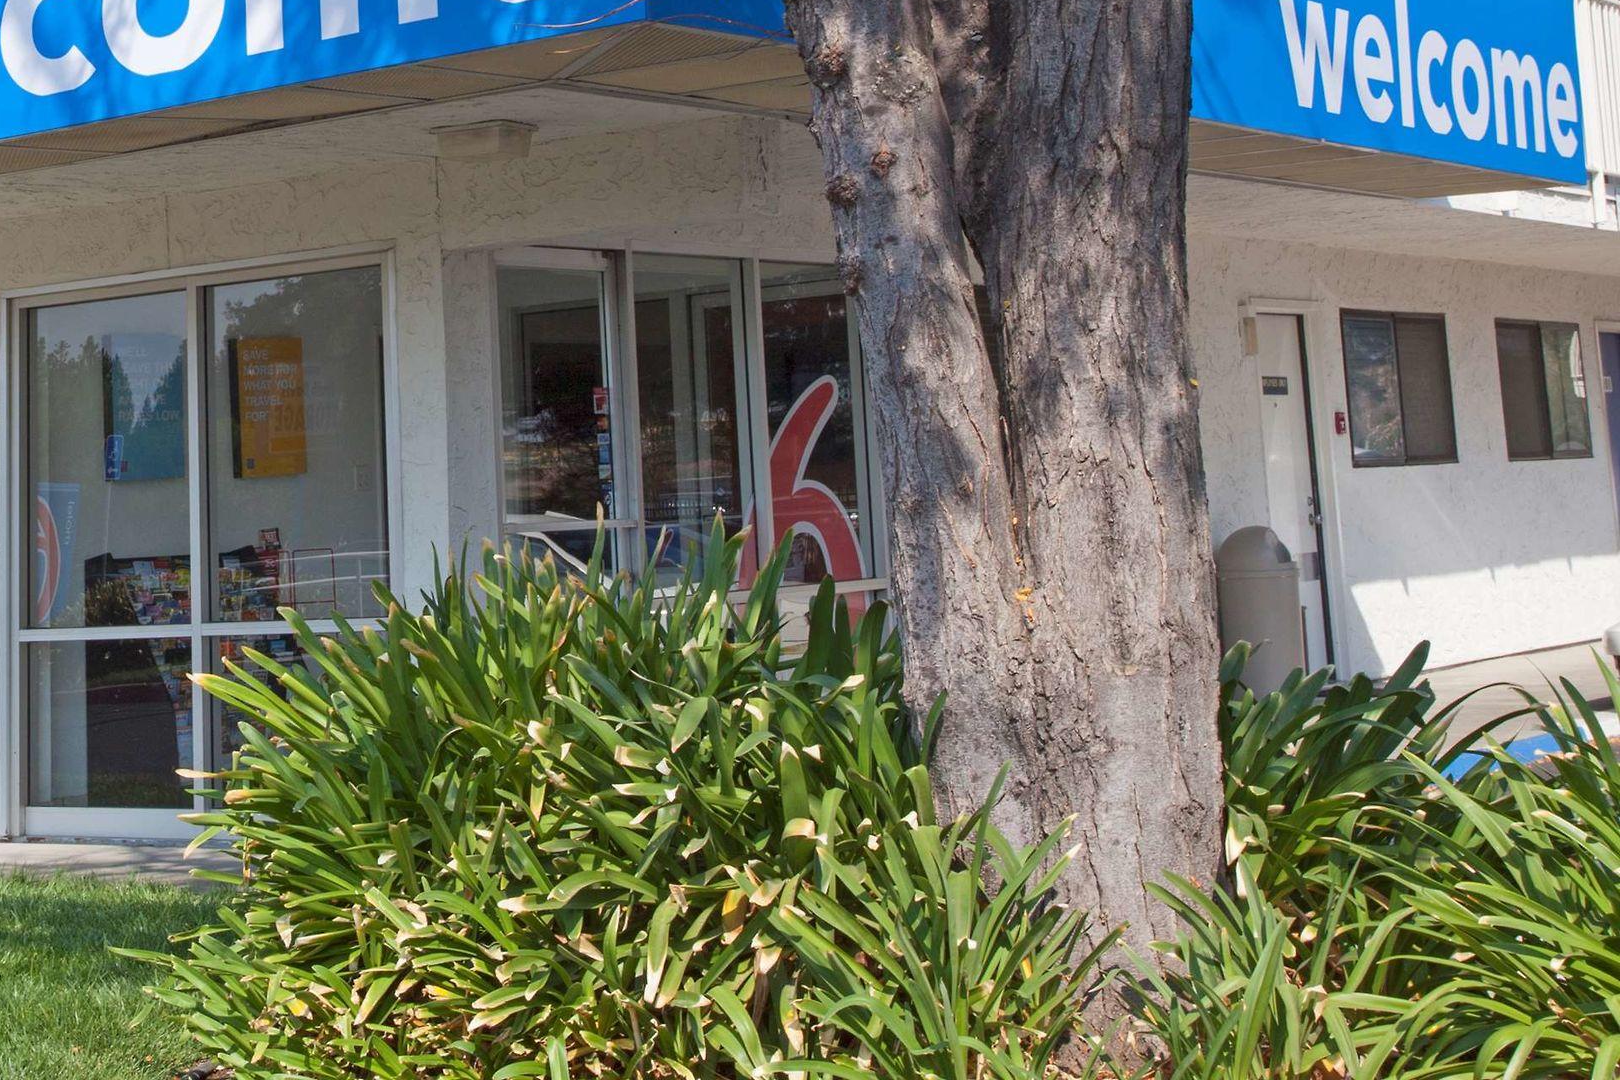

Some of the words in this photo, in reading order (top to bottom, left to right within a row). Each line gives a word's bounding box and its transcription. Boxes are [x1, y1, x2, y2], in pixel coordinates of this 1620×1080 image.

[243, 348, 269, 361] SAVE
[244, 380, 271, 392] WHAT
[275, 378, 297, 390] YOU
[246, 395, 285, 408] TRAVEL
